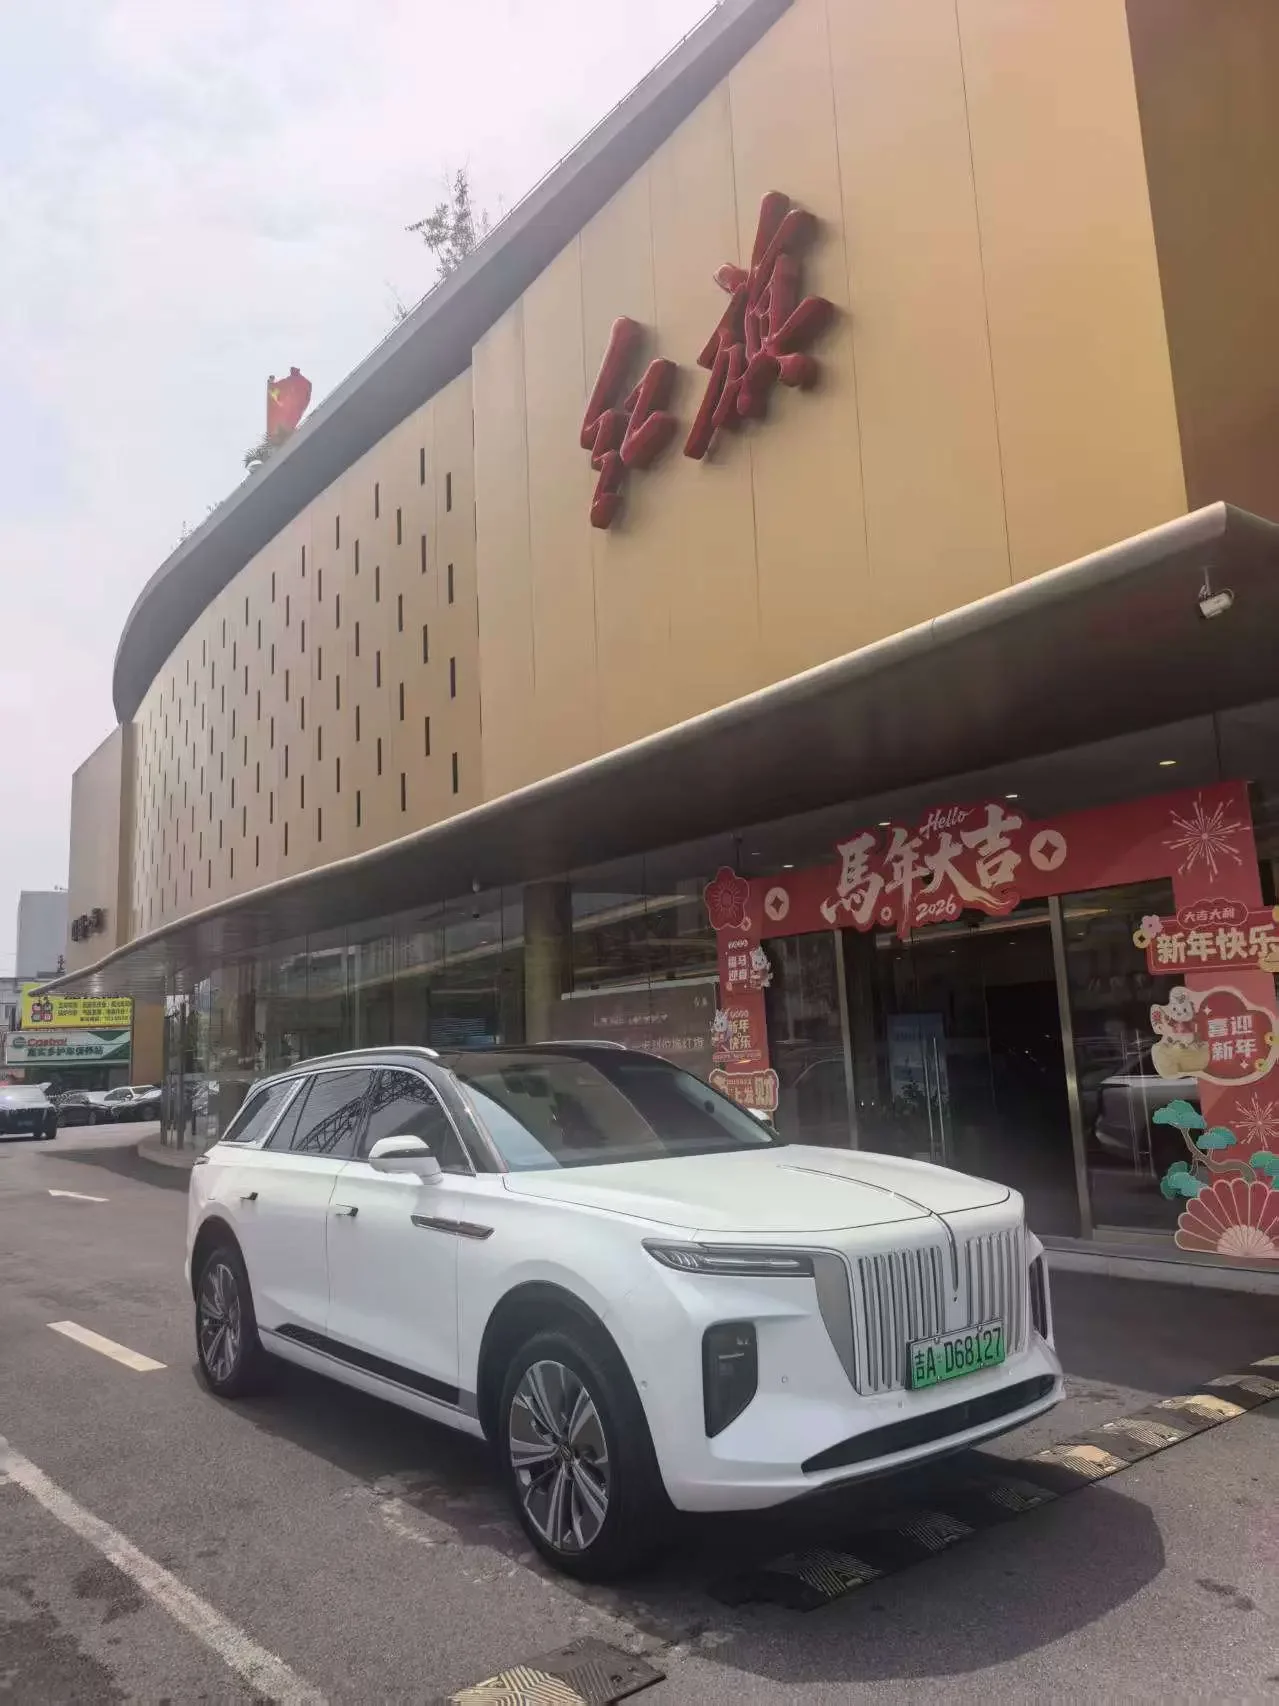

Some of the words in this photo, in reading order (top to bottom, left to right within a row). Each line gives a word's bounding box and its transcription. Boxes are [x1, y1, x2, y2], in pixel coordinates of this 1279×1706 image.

[919, 807, 975, 840] Hello
[915, 895, 956, 922] 2026
[1184, 907, 1236, 923] 大吉大利
[1156, 923, 1279, 964] 新年快乐
[1207, 1015, 1253, 1037] 喜迎
[1211, 1038, 1258, 1061] 新年
